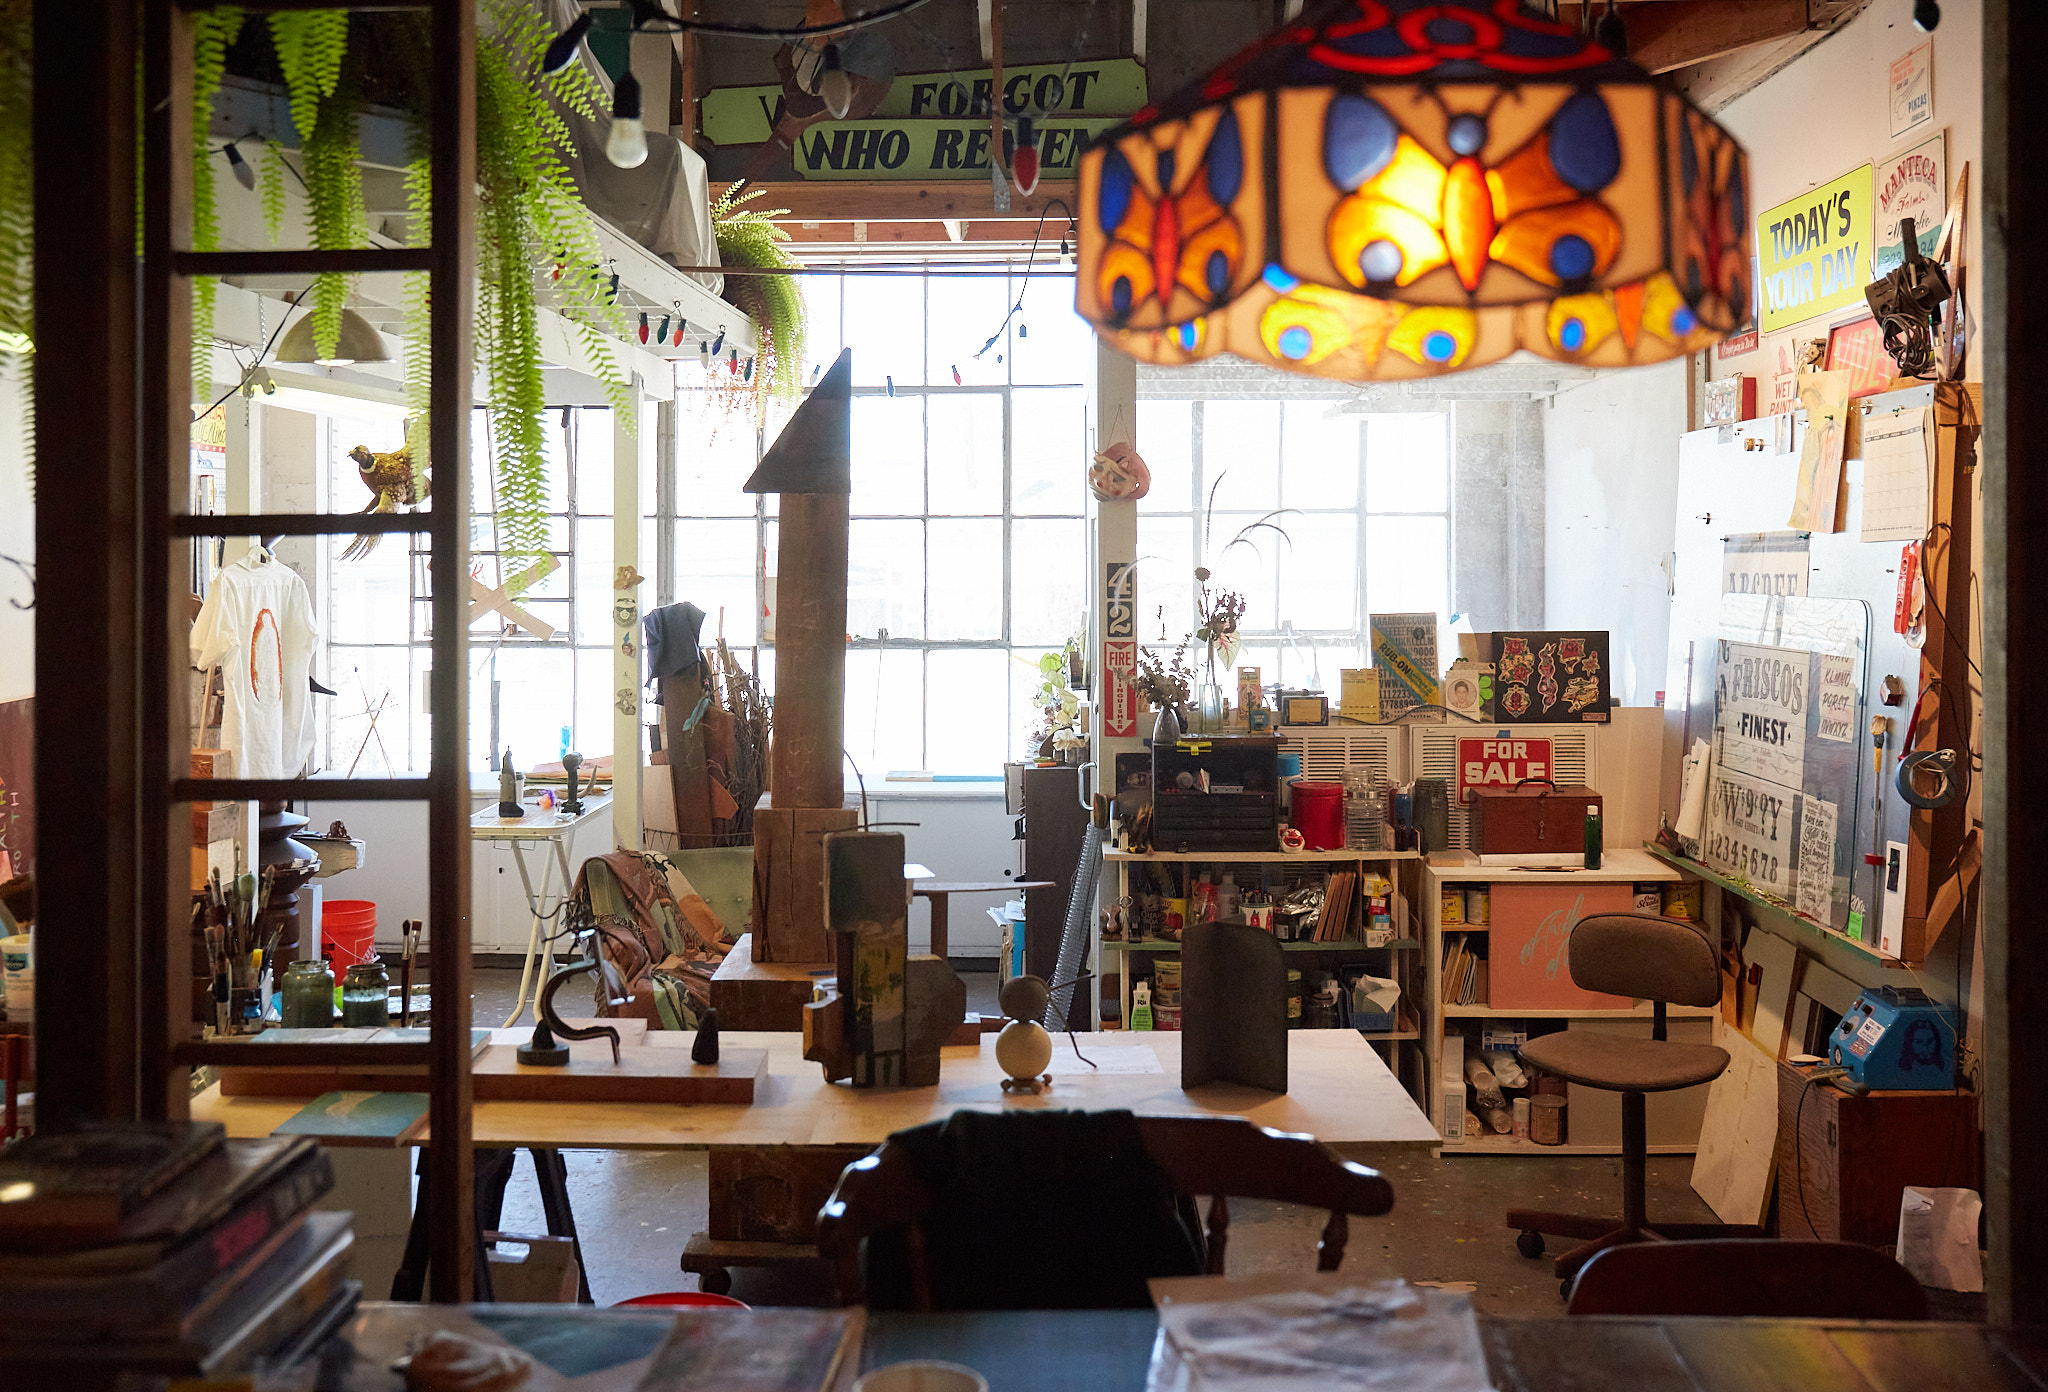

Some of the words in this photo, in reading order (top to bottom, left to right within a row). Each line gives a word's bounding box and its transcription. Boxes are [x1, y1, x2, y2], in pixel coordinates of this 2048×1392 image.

[910, 70, 1100, 117] FORGOT
[799, 129, 911, 170] WHO
[1879, 154, 1938, 213] MANTECA
[1769, 189, 1852, 264] TODAY'S
[1764, 261, 1815, 315] YOUR
[1820, 241, 1860, 299] DAY
[1768, 398, 1794, 416] PAINT
[1775, 381, 1792, 400] WET
[1109, 651, 1131, 666] FIRE
[1378, 642, 1413, 676] RUB-ON
[1731, 658, 1804, 716] FRISCO'S
[1741, 713, 1789, 747] FINEST
[1483, 741, 1529, 759] FOR
[1464, 761, 1546, 785] SALE
[1709, 829, 1779, 884] 12345678
